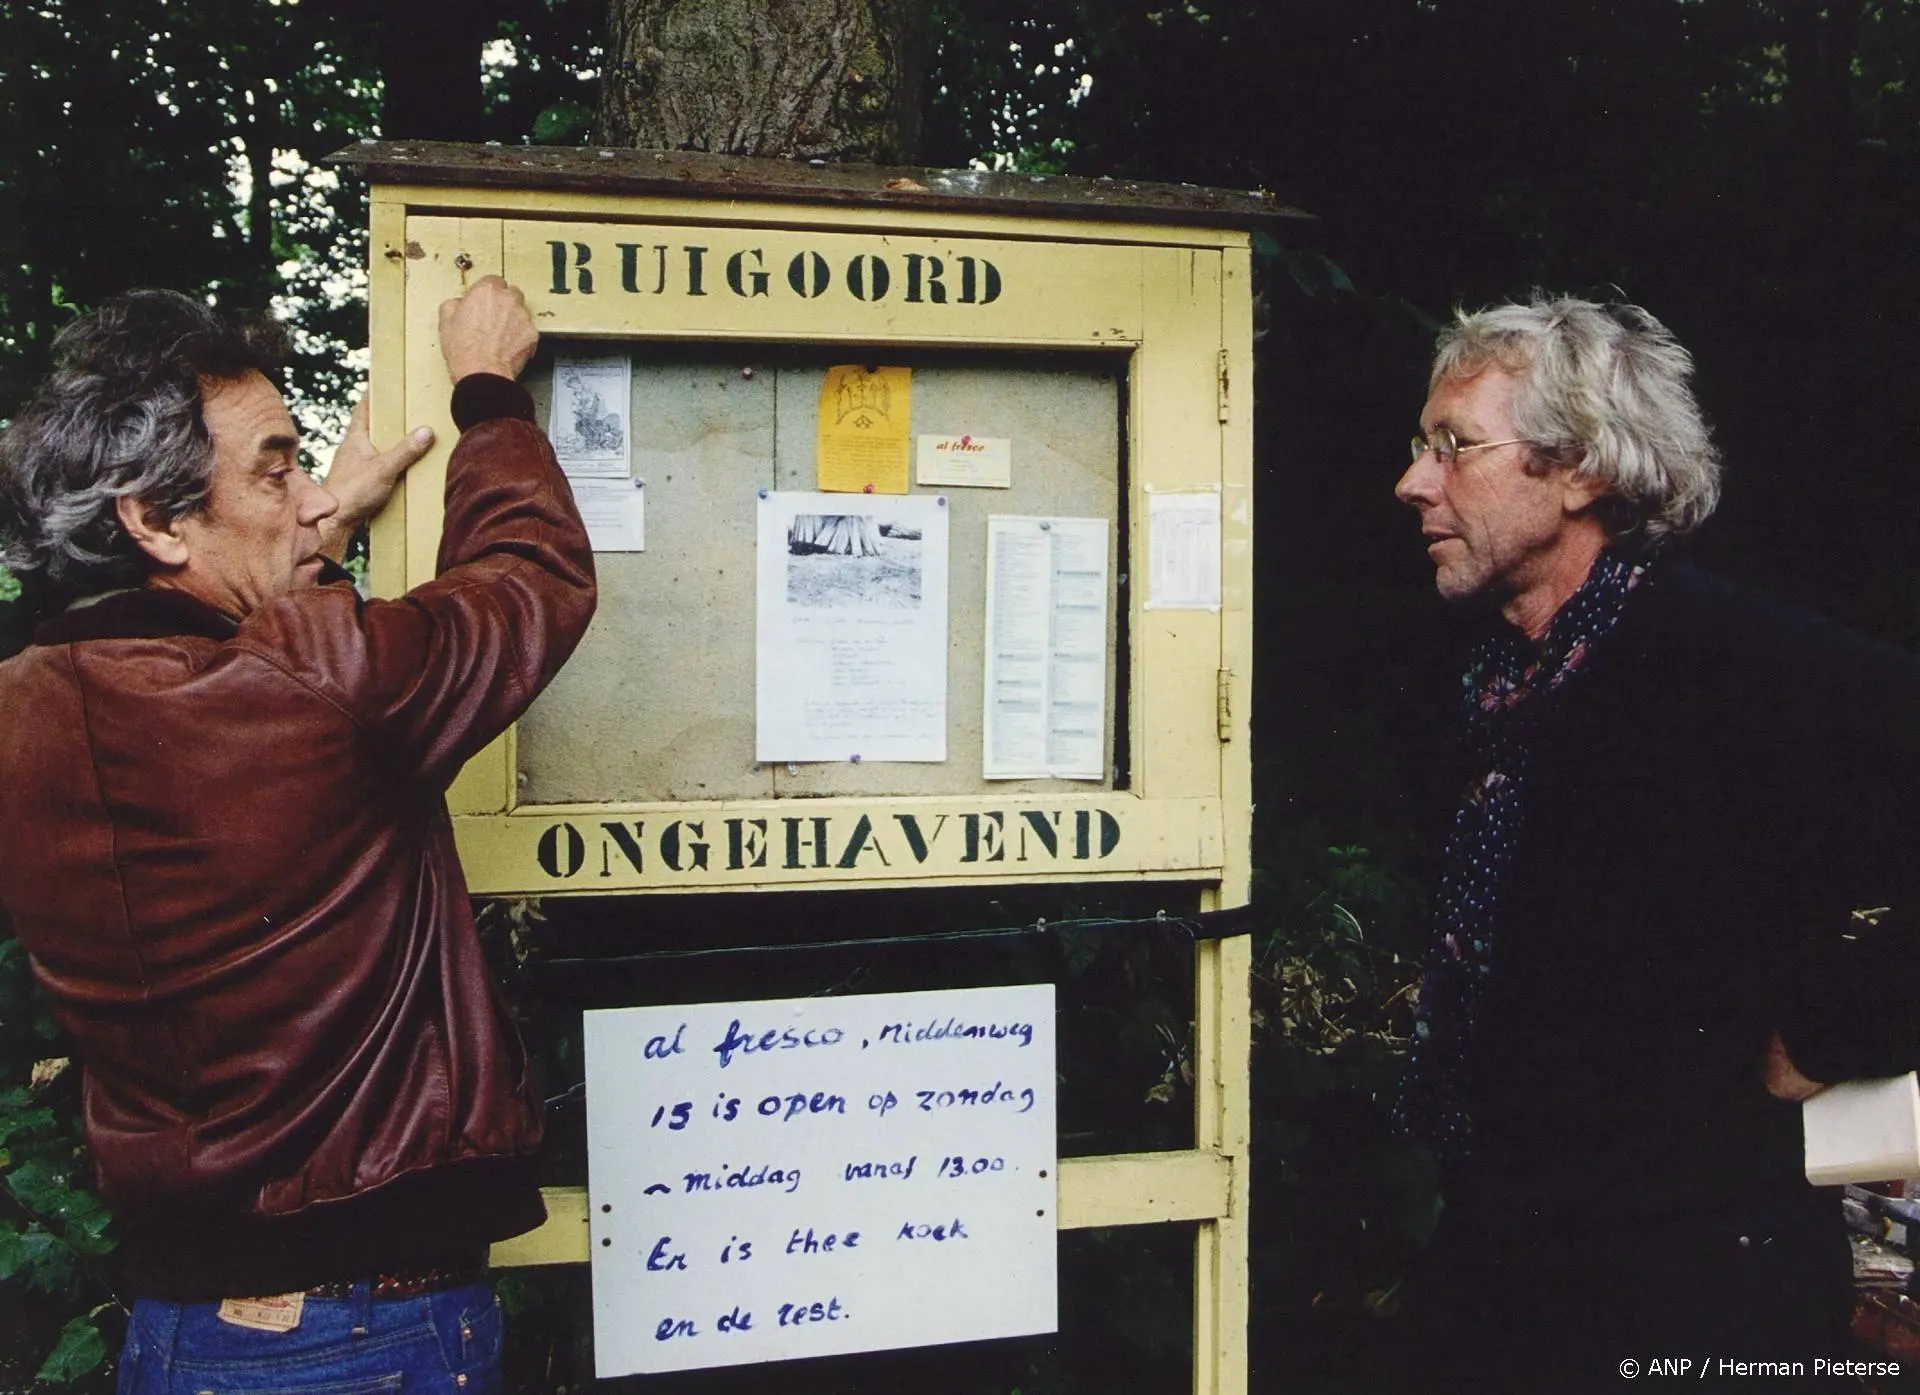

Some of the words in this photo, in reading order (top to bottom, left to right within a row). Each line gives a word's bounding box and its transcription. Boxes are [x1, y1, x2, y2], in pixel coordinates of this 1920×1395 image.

[546, 240, 1002, 305] RUIGOORD
[537, 809, 1121, 878] ONGEHAVEND
[643, 1022, 688, 1060] al
[650, 1101, 694, 1131] 15
[712, 1091, 742, 1122] is
[756, 1091, 846, 1123] open
[868, 1090, 898, 1118] op
[915, 1080, 1035, 1113] zondag
[646, 1235, 688, 1272] Er
[720, 1235, 753, 1265] is
[785, 1227, 861, 1255] thee
[654, 1317, 700, 1342] en
[716, 1305, 754, 1334] de
